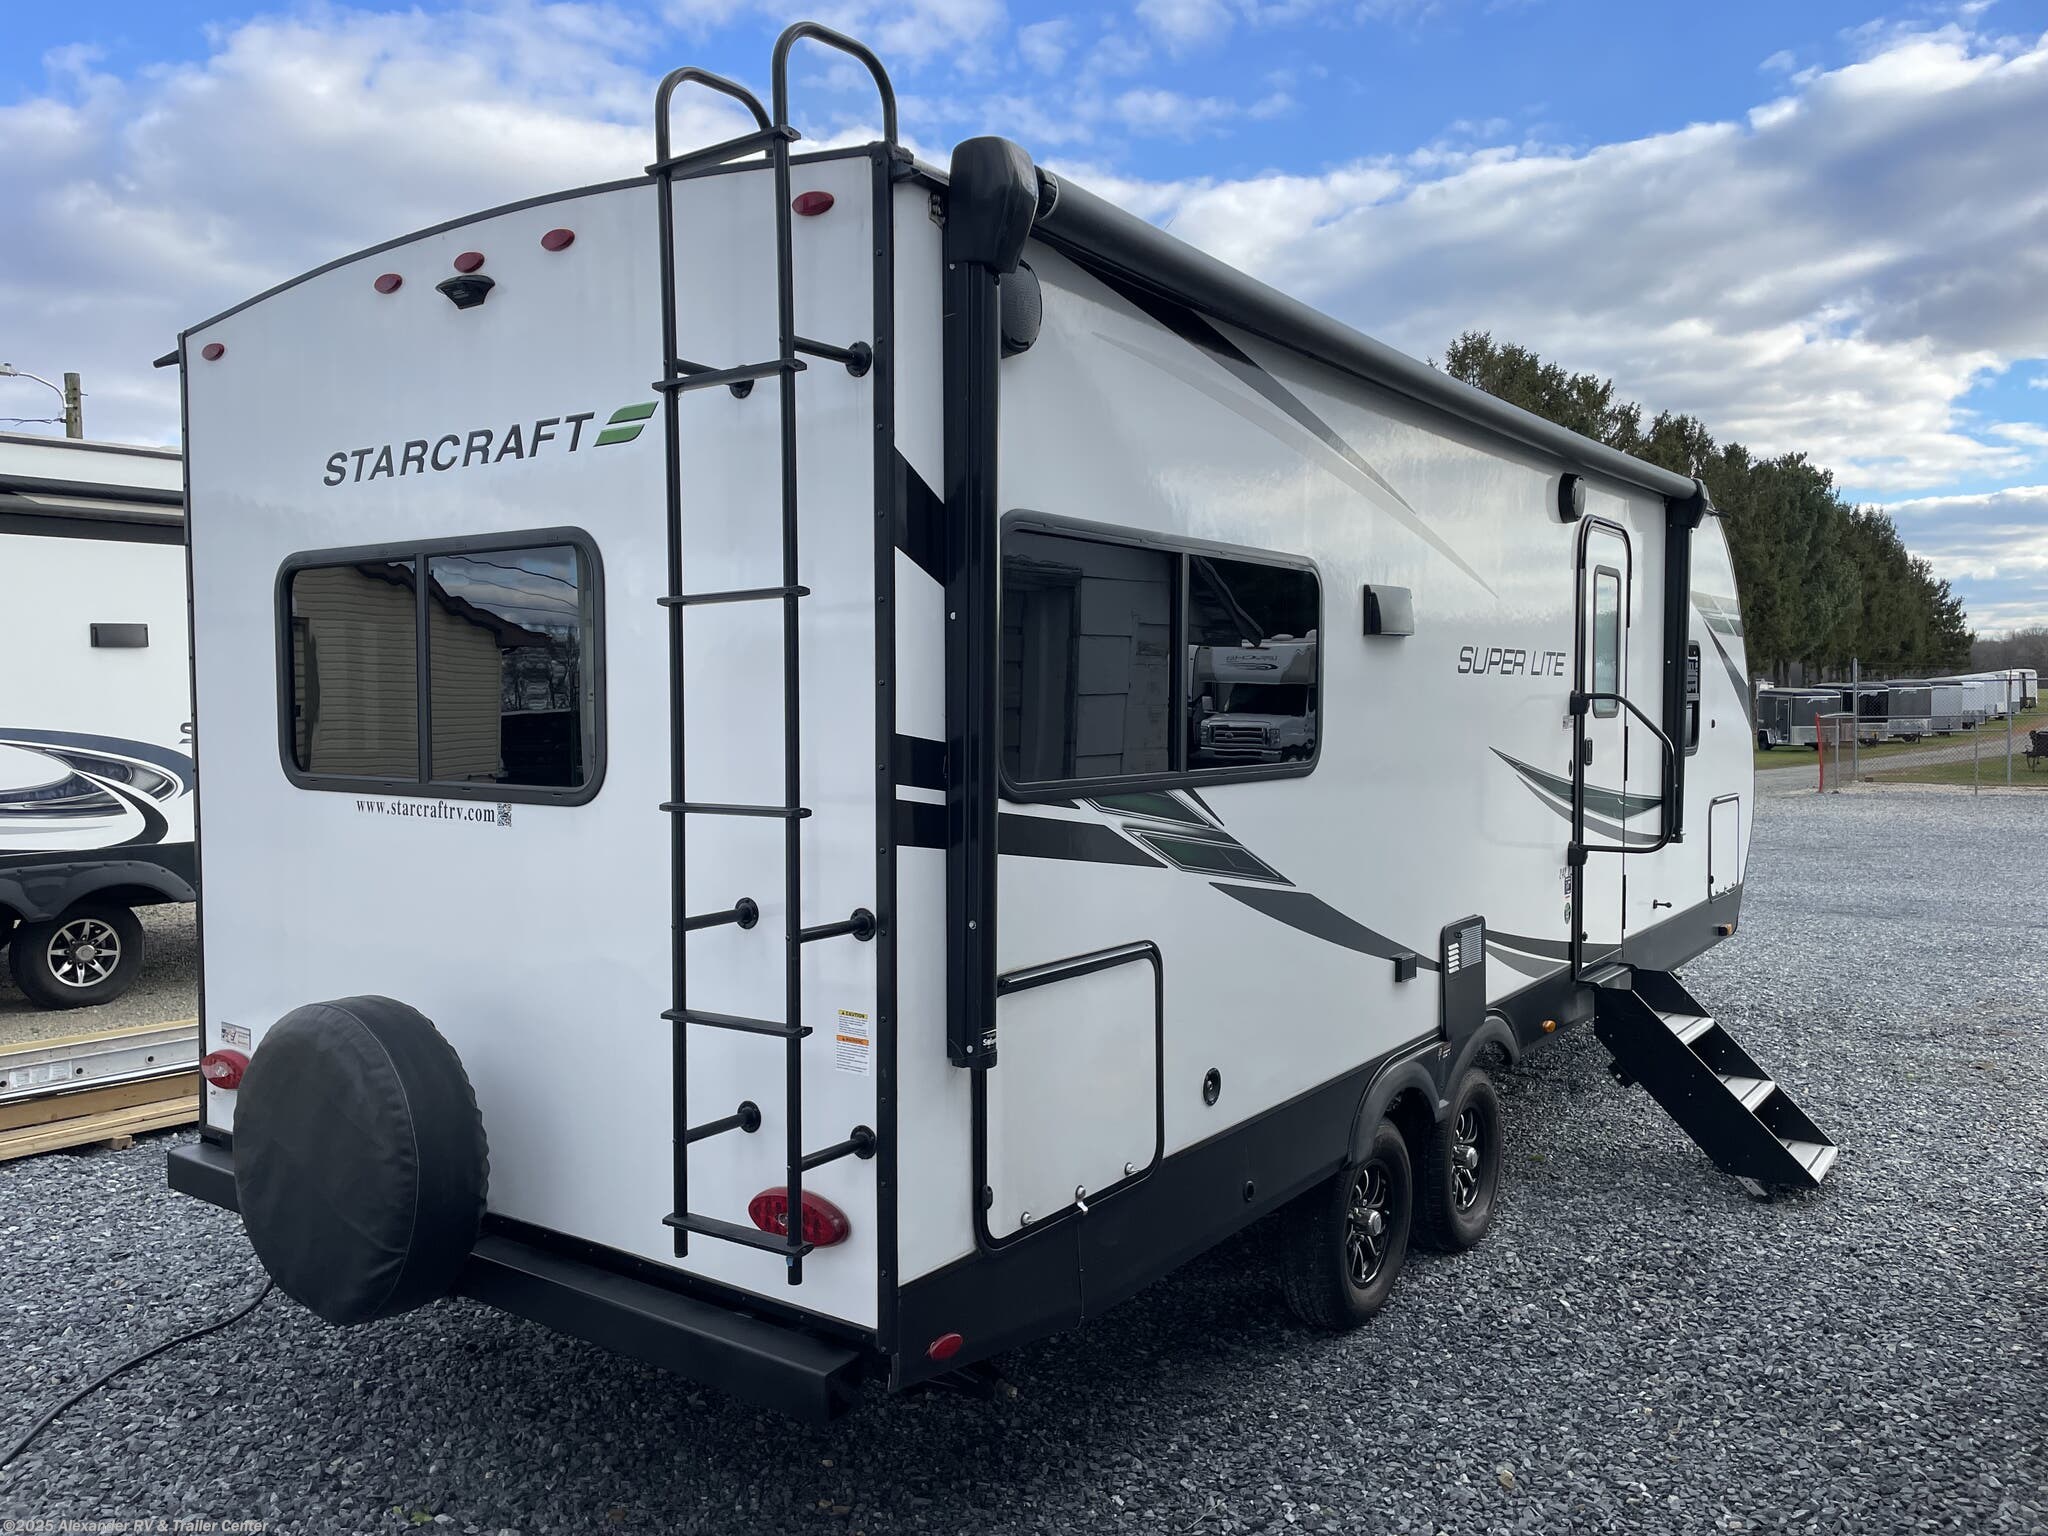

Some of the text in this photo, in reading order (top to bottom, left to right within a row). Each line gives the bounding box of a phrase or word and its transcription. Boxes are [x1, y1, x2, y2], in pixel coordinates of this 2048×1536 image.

[323, 411, 595, 487] STARCRAFT
[1457, 645, 1567, 676] SUPER LITE
[356, 799, 495, 822] www.starcraftrv.com
